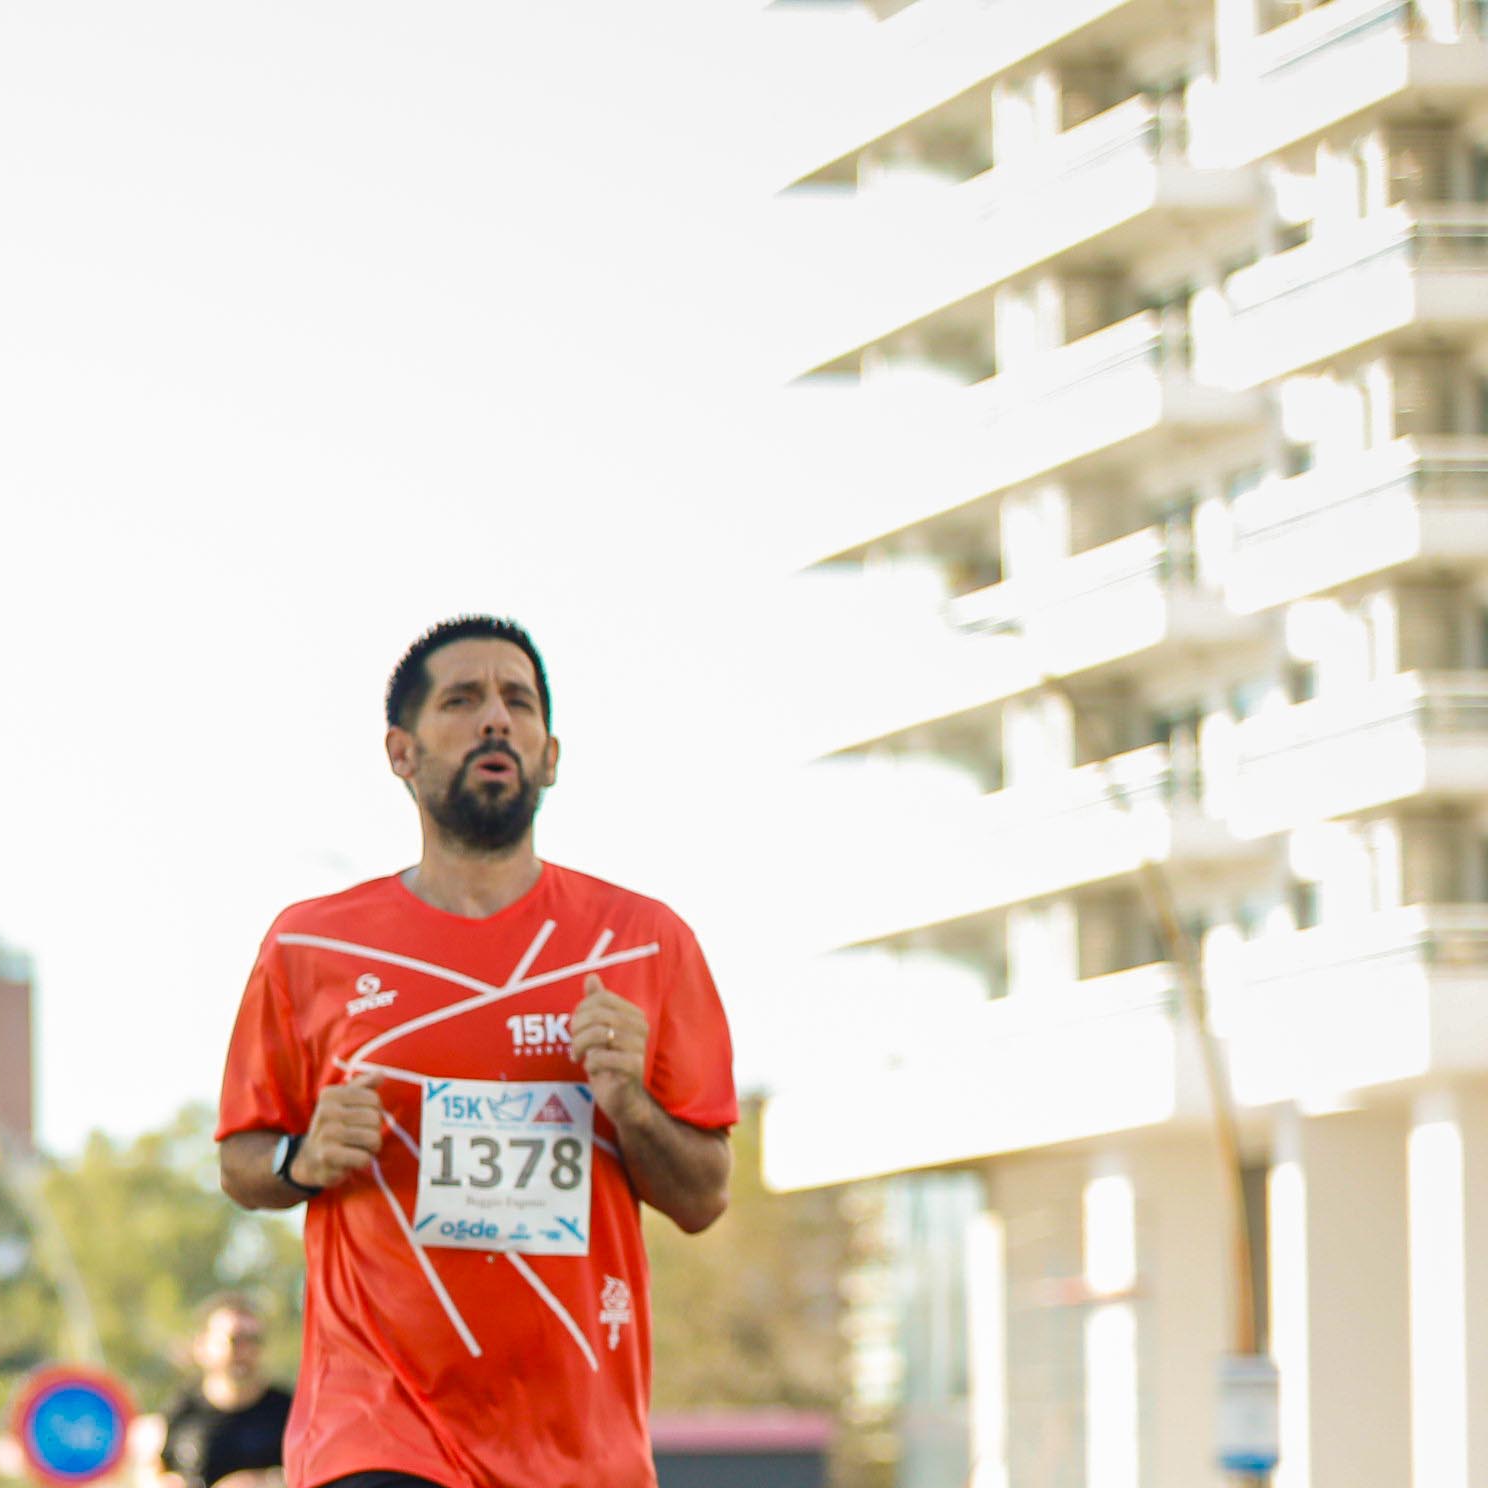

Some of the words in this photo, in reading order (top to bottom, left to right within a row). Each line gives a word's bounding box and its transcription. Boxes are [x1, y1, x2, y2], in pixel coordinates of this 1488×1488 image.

[506, 1013, 572, 1046] 15K
[441, 1095, 484, 1121] 15K
[430, 1135, 583, 1190] 1378
[439, 1217, 499, 1240] osde
